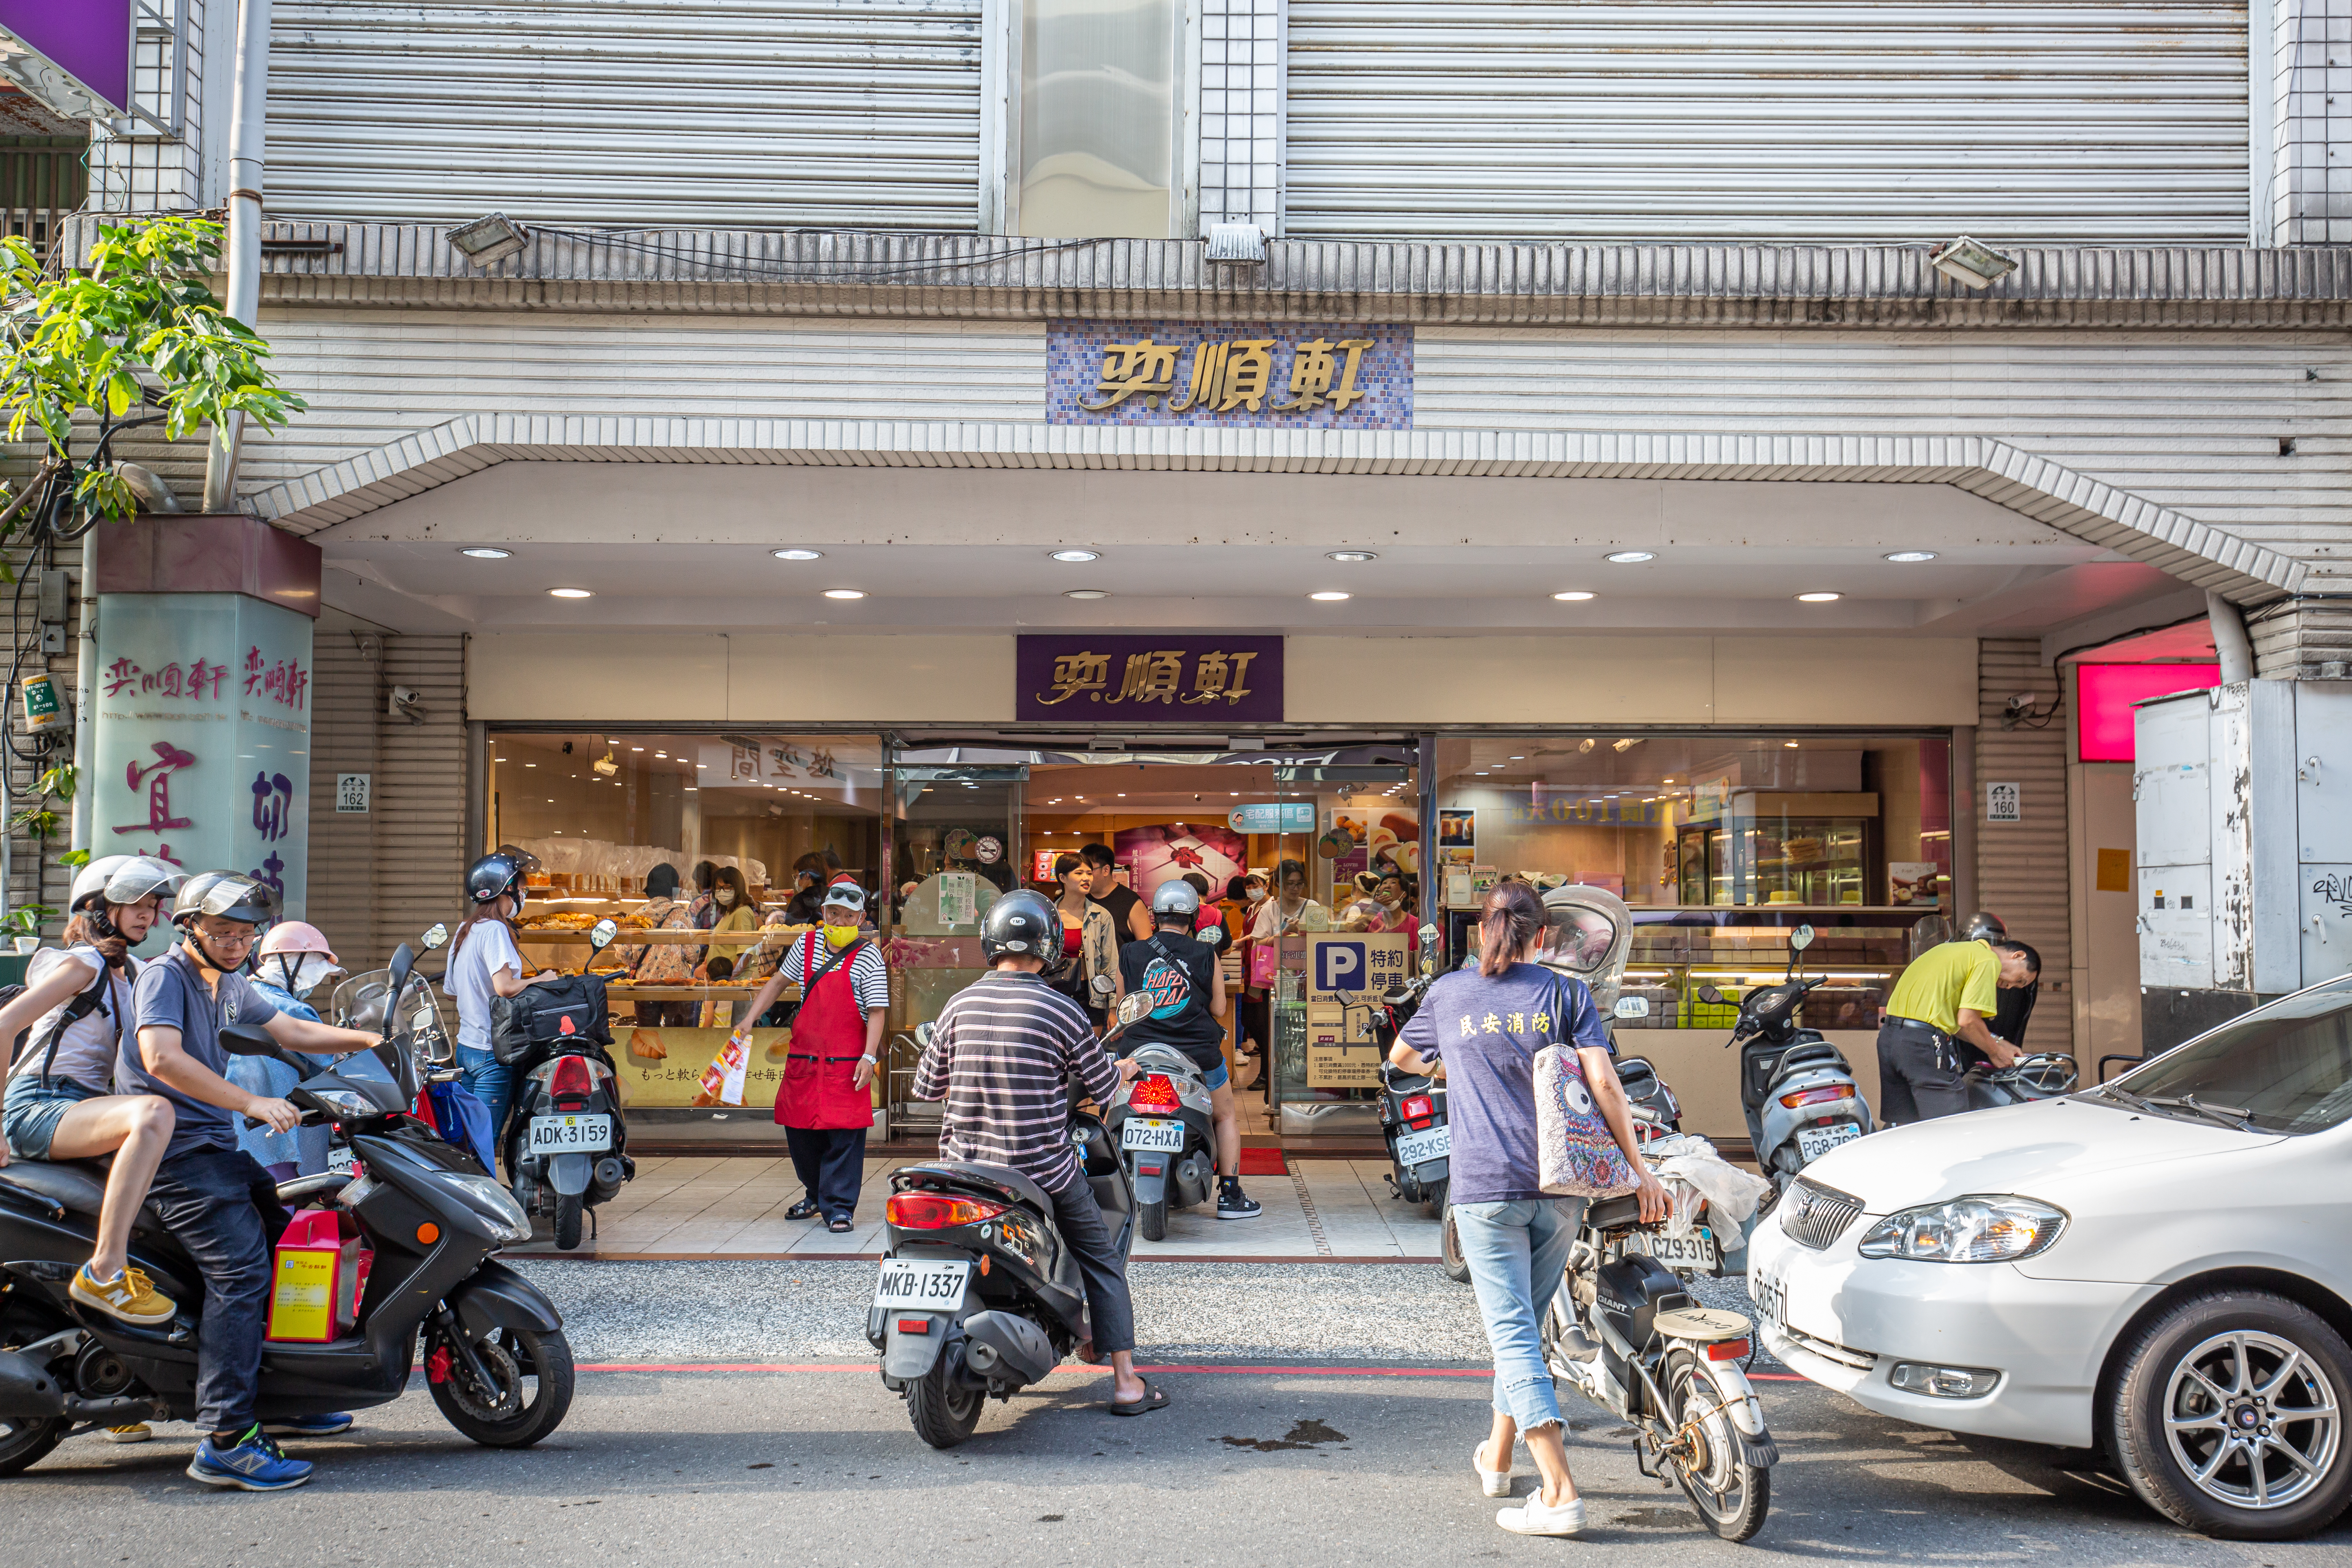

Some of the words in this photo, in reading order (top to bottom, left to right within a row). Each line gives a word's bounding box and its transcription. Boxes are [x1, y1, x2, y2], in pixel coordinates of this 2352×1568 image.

[1076, 337, 1376, 413] 奕順軒
[103, 657, 227, 700] 奕順軒
[244, 645, 308, 711] 奕順軒
[1036, 650, 1258, 706] 奕順軒
[343, 793, 363, 805] 162
[1994, 801, 2014, 813] 160
[1245, 808, 1294, 819] 宅配服務區
[1327, 947, 1358, 987] P
[1370, 949, 1403, 968] 特約
[1370, 972, 1403, 990] 停車
[1151, 987, 1187, 1007] DAI
[1460, 1011, 1550, 1037] 民安消防
[567, 1117, 573, 1125] 6
[534, 1125, 608, 1145] ADK-3159
[1125, 1129, 1181, 1147] 072-HXA
[1817, 1128, 1840, 1137] 台灣省
[1652, 1237, 1714, 1261] CZ9-315
[879, 1272, 964, 1298] MKB-1337
[1597, 1294, 1627, 1312] GIANT
